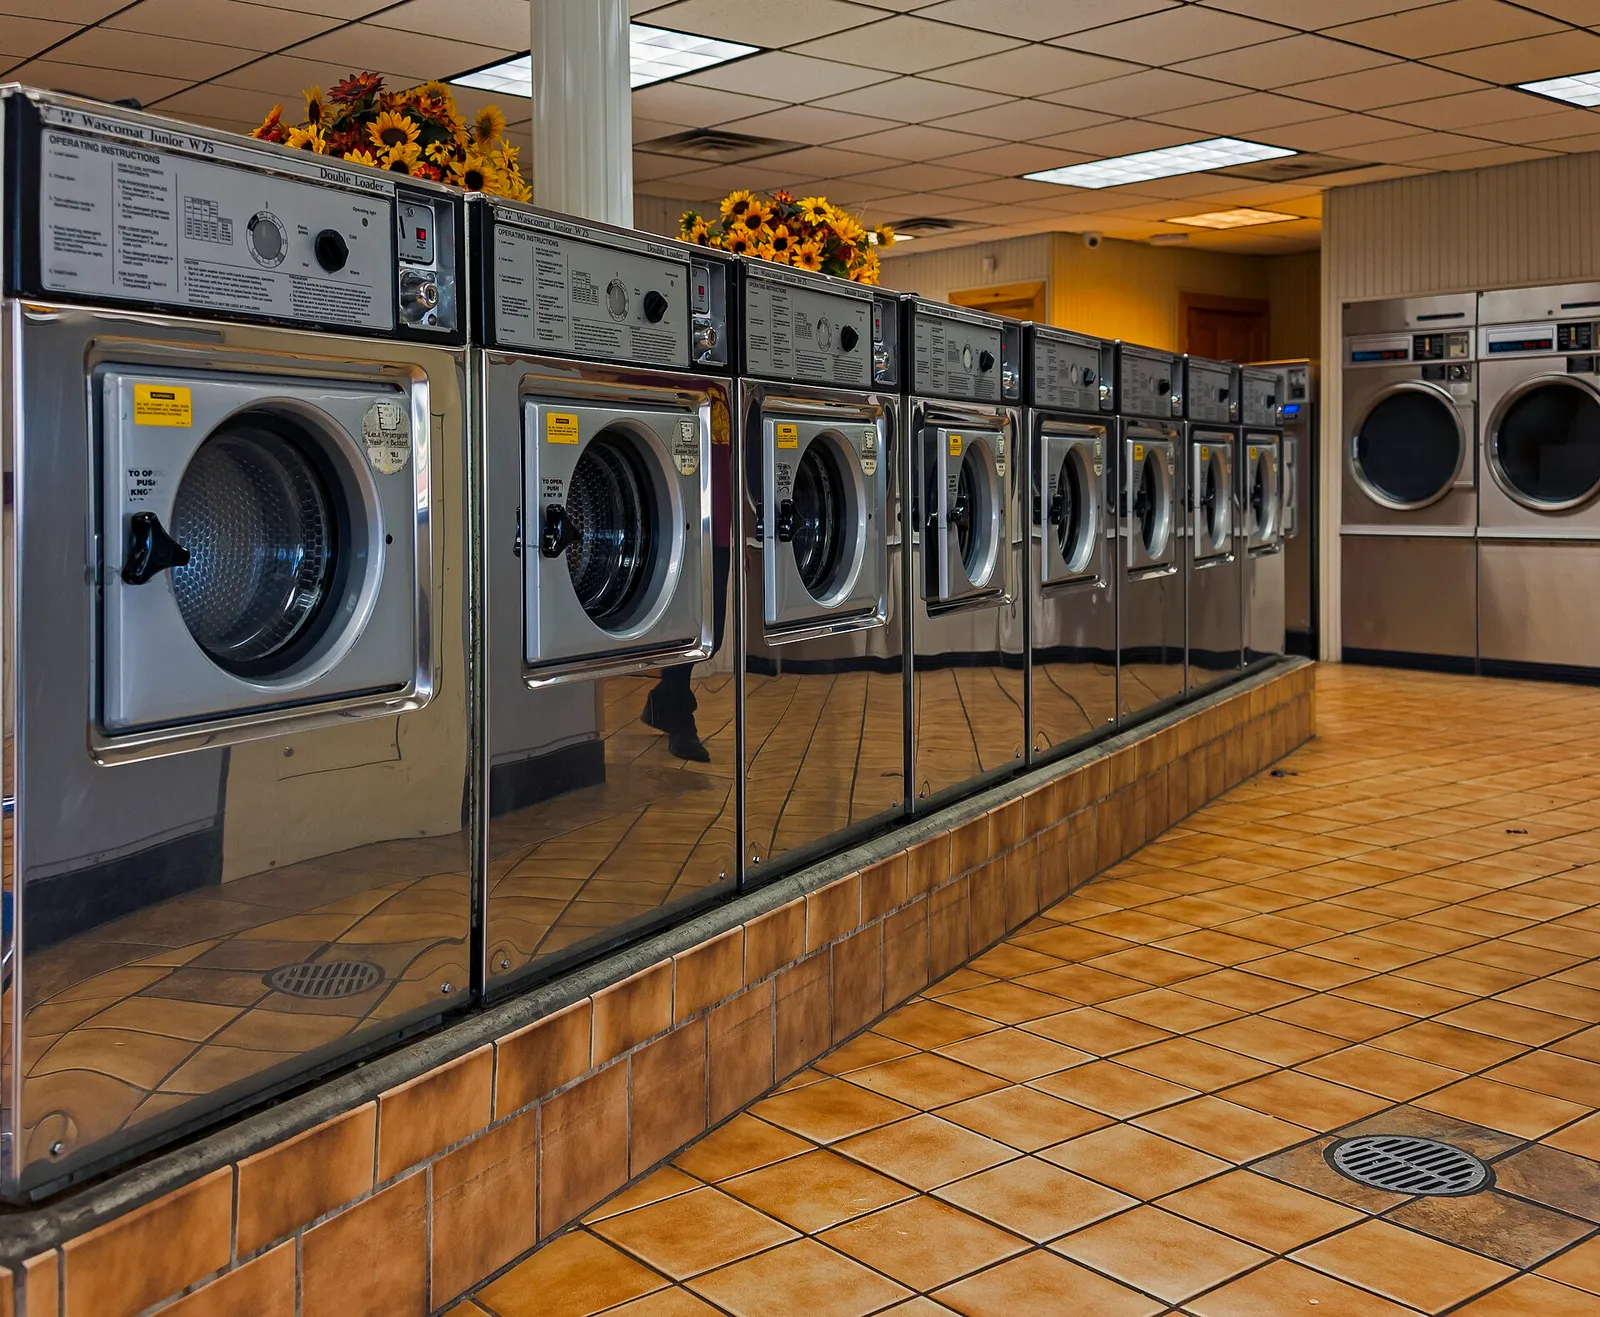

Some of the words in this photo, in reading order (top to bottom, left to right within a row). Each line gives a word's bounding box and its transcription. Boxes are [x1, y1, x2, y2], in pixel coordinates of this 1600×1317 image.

[82, 114, 144, 139] Wascomat
[149, 128, 184, 148] Junior
[50, 136, 99, 152] OPERATING
[101, 146, 160, 165] INSTRUCTIONS
[320, 168, 351, 184] Double
[355, 175, 384, 192] Loader
[516, 213, 550, 229] Wascomat
[554, 220, 573, 233] Junior
[498, 228, 525, 240] OPERATING
[526, 234, 558, 247] INSTRUCTIONS
[647, 243, 664, 255] Double
[666, 249, 683, 259] Loader
